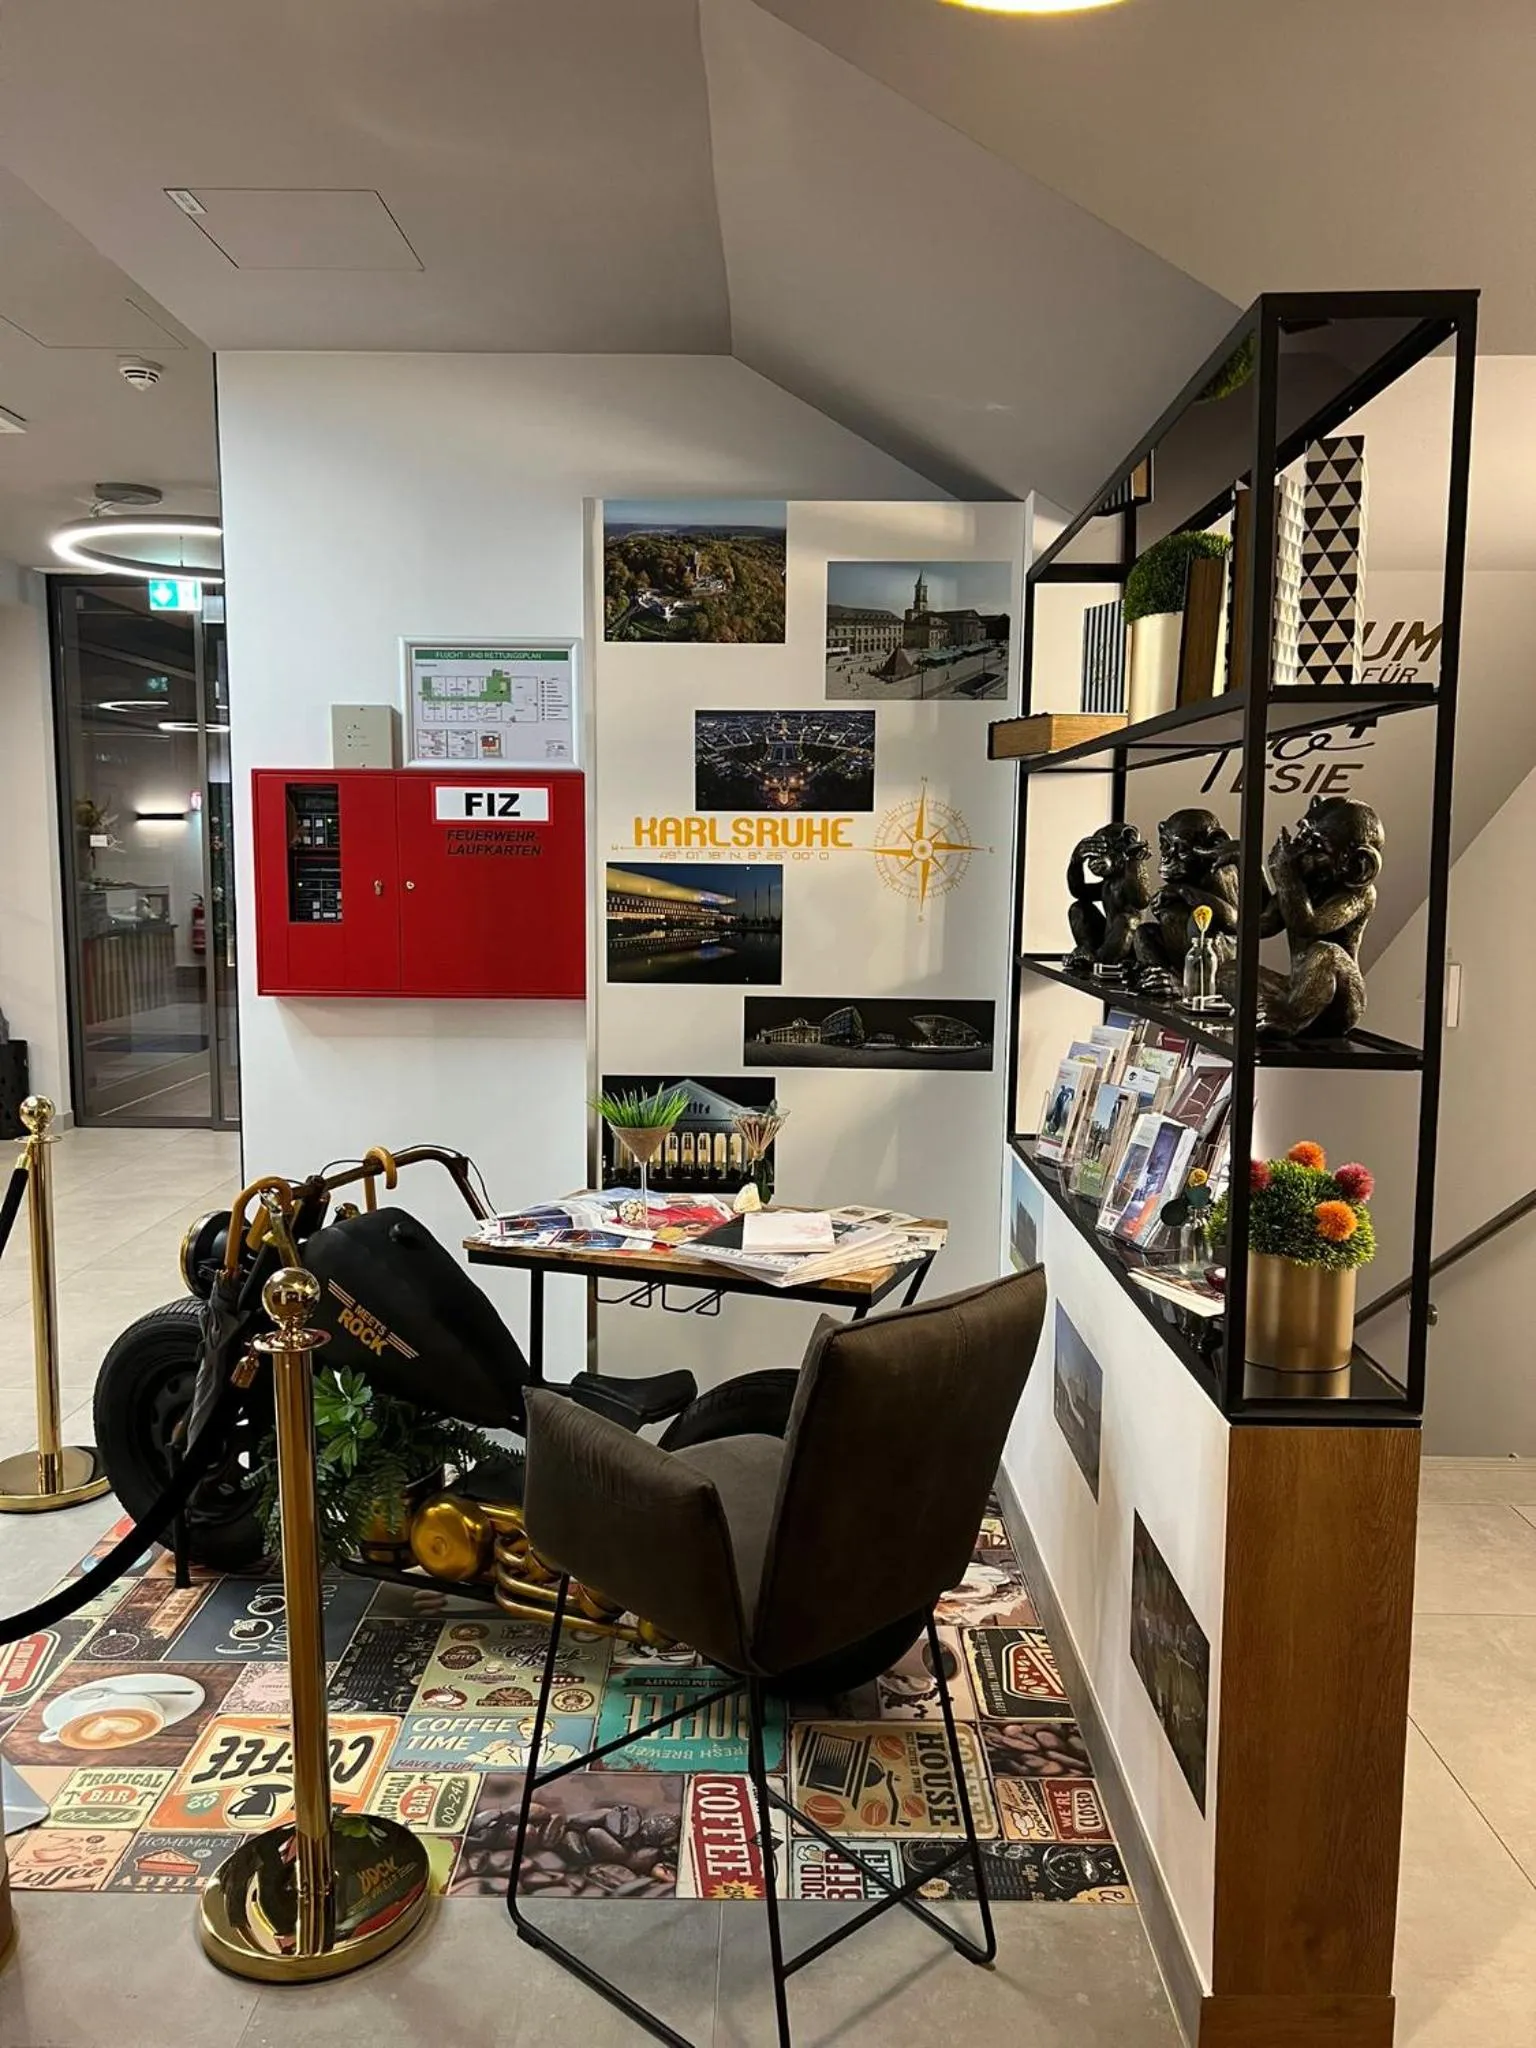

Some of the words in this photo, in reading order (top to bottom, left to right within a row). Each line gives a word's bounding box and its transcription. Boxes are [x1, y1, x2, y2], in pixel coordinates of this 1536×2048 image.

[464, 792, 521, 818] FIZ
[447, 829, 540, 843] FEUERWEHR-
[634, 816, 855, 848] KARLSRUHE
[447, 843, 542, 857] LAUFKARTEN
[337, 1307, 389, 1357] ROCK
[354, 1304, 387, 1335] MEETS
[411, 1717, 518, 1734] COFFEE
[406, 1735, 473, 1751] TIME
[624, 1744, 694, 1761] BREWED
[191, 1736, 374, 1784] CFEE
[77, 1773, 164, 1788] TROPICAL
[915, 1731, 960, 1827] HOUSE
[88, 1790, 130, 1802] BAR
[377, 1775, 415, 1820] ROPICAL
[406, 1788, 434, 1817] BAR
[1053, 1791, 1073, 1829] WE'RE
[1076, 1791, 1101, 1828] CLOSED
[139, 1837, 234, 1848] HOMEMADE
[696, 1783, 753, 1876] COFFEE
[9, 1866, 105, 1887] Coffee
[115, 1875, 209, 1888] APPLE
